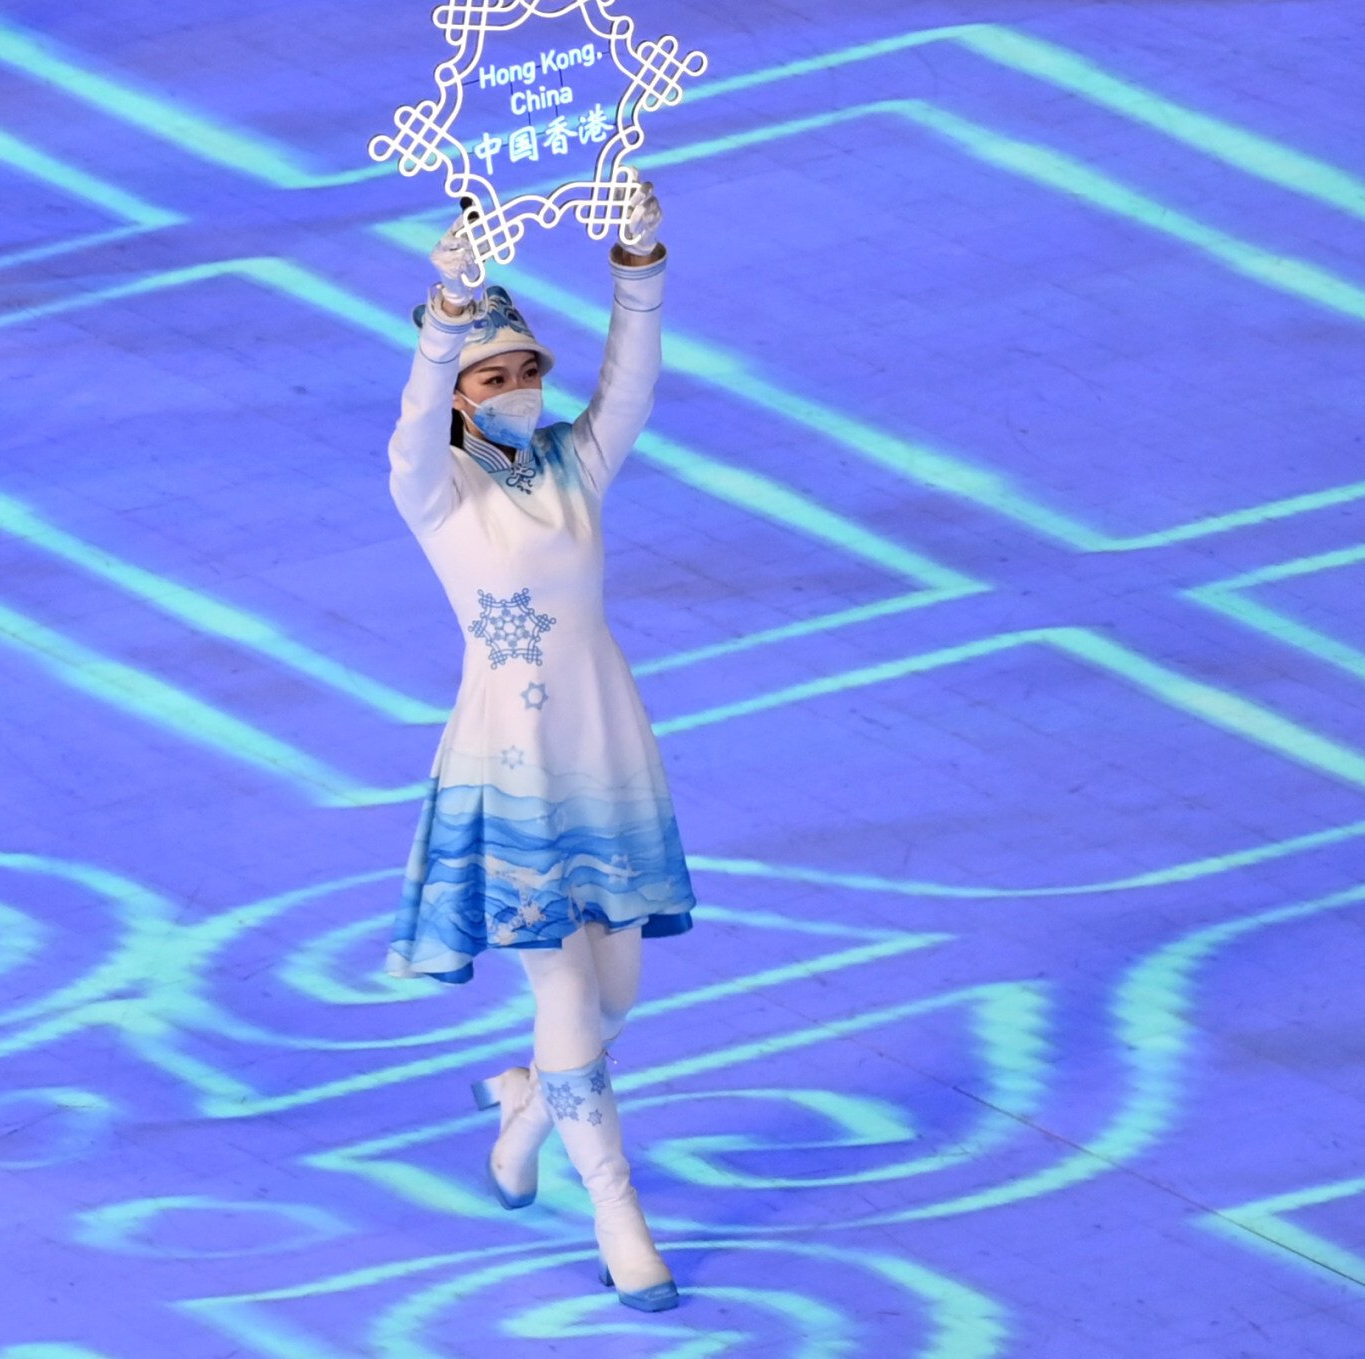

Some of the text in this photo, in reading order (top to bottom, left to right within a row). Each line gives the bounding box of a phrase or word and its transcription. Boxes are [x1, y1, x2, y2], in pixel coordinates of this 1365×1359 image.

[479, 60, 536, 89] Hong
[510, 85, 574, 116] China
[474, 102, 615, 176] 中国香港
